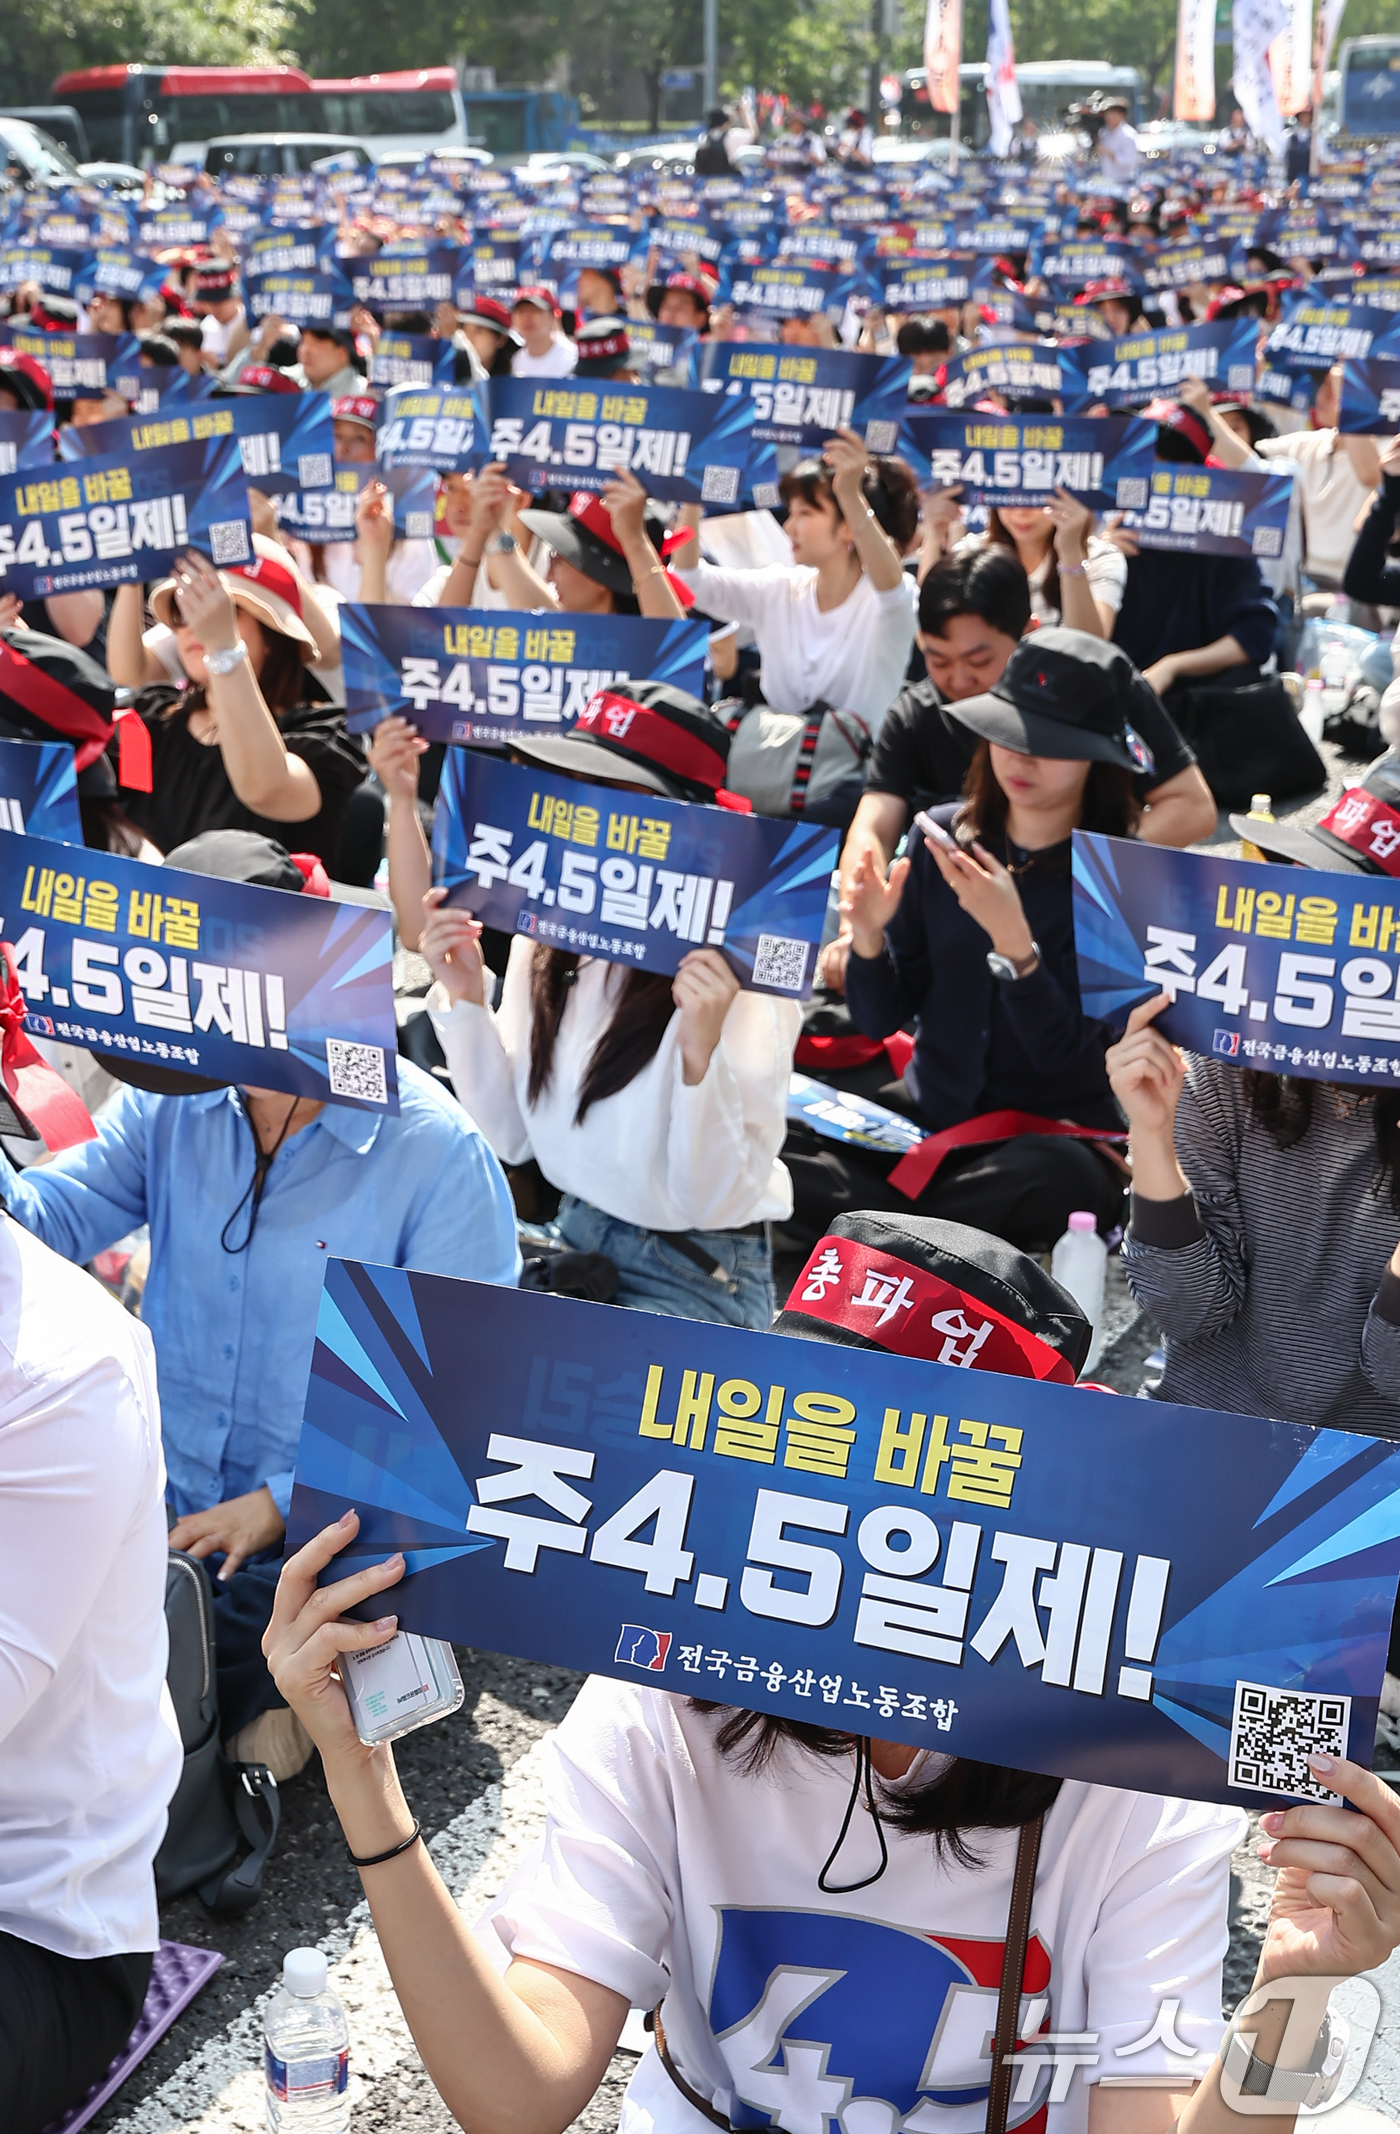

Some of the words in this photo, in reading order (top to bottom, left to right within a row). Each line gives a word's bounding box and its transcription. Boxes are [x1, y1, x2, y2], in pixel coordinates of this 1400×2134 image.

[376, 417, 475, 457] 4.5일
[532, 389, 598, 421] 내일을
[601, 394, 648, 426] 바꿀
[488, 417, 692, 477] 주4.5일제!
[930, 449, 1104, 491] 주4.5일제!
[15, 476, 81, 516] 내일을
[83, 466, 132, 504] 바꿀
[443, 624, 519, 660] 내일을
[524, 628, 576, 664] 바꿀
[400, 656, 630, 723] 주4.5일제
[527, 792, 600, 847] 내일을
[606, 812, 671, 861] 바꿀
[21, 865, 119, 933] 내일을
[127, 889, 201, 951] 바꿀
[465, 822, 735, 947] 주4.5일제!
[1215, 884, 1338, 946] 내일을
[1349, 903, 1400, 953] 바
[0, 915, 289, 1051] 4.5일제!
[55, 1020, 200, 1066] 전국금융산업노동조합
[801, 1248, 994, 1369] 총파업
[638, 1364, 857, 1479] 내일을
[873, 1407, 1024, 1509] 바꿀
[465, 1432, 1171, 1702] 주4.5일제!
[676, 1642, 960, 1733] 전국금융산업노동조합
